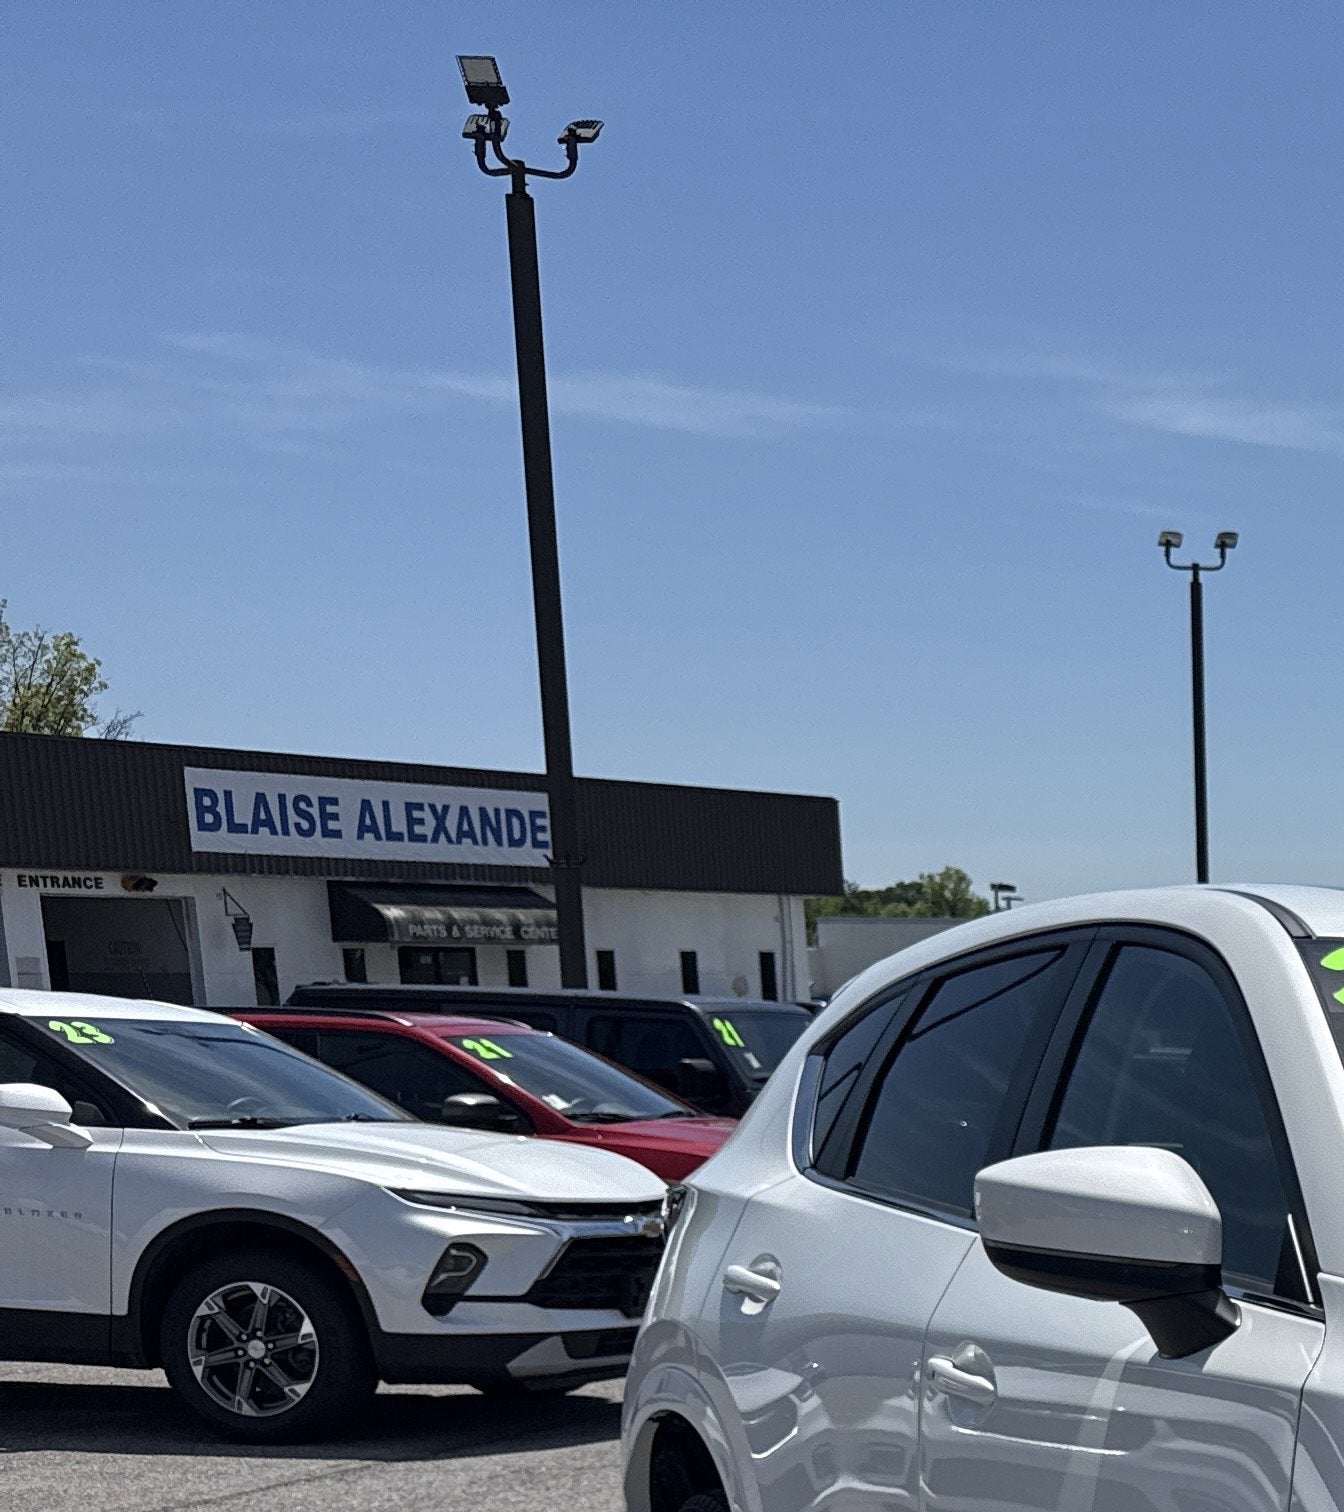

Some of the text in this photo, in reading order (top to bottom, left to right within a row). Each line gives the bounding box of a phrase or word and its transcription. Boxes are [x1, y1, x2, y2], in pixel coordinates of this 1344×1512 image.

[193, 786, 550, 850] BLAISE ALEXANDE
[16, 873, 105, 890] ENTRANCE
[408, 923, 448, 938] PARTS
[465, 924, 514, 940] SERVICE
[520, 925, 559, 940] CENTE
[48, 1020, 115, 1045] 23
[712, 1017, 746, 1048] 21
[462, 1038, 514, 1060] 21
